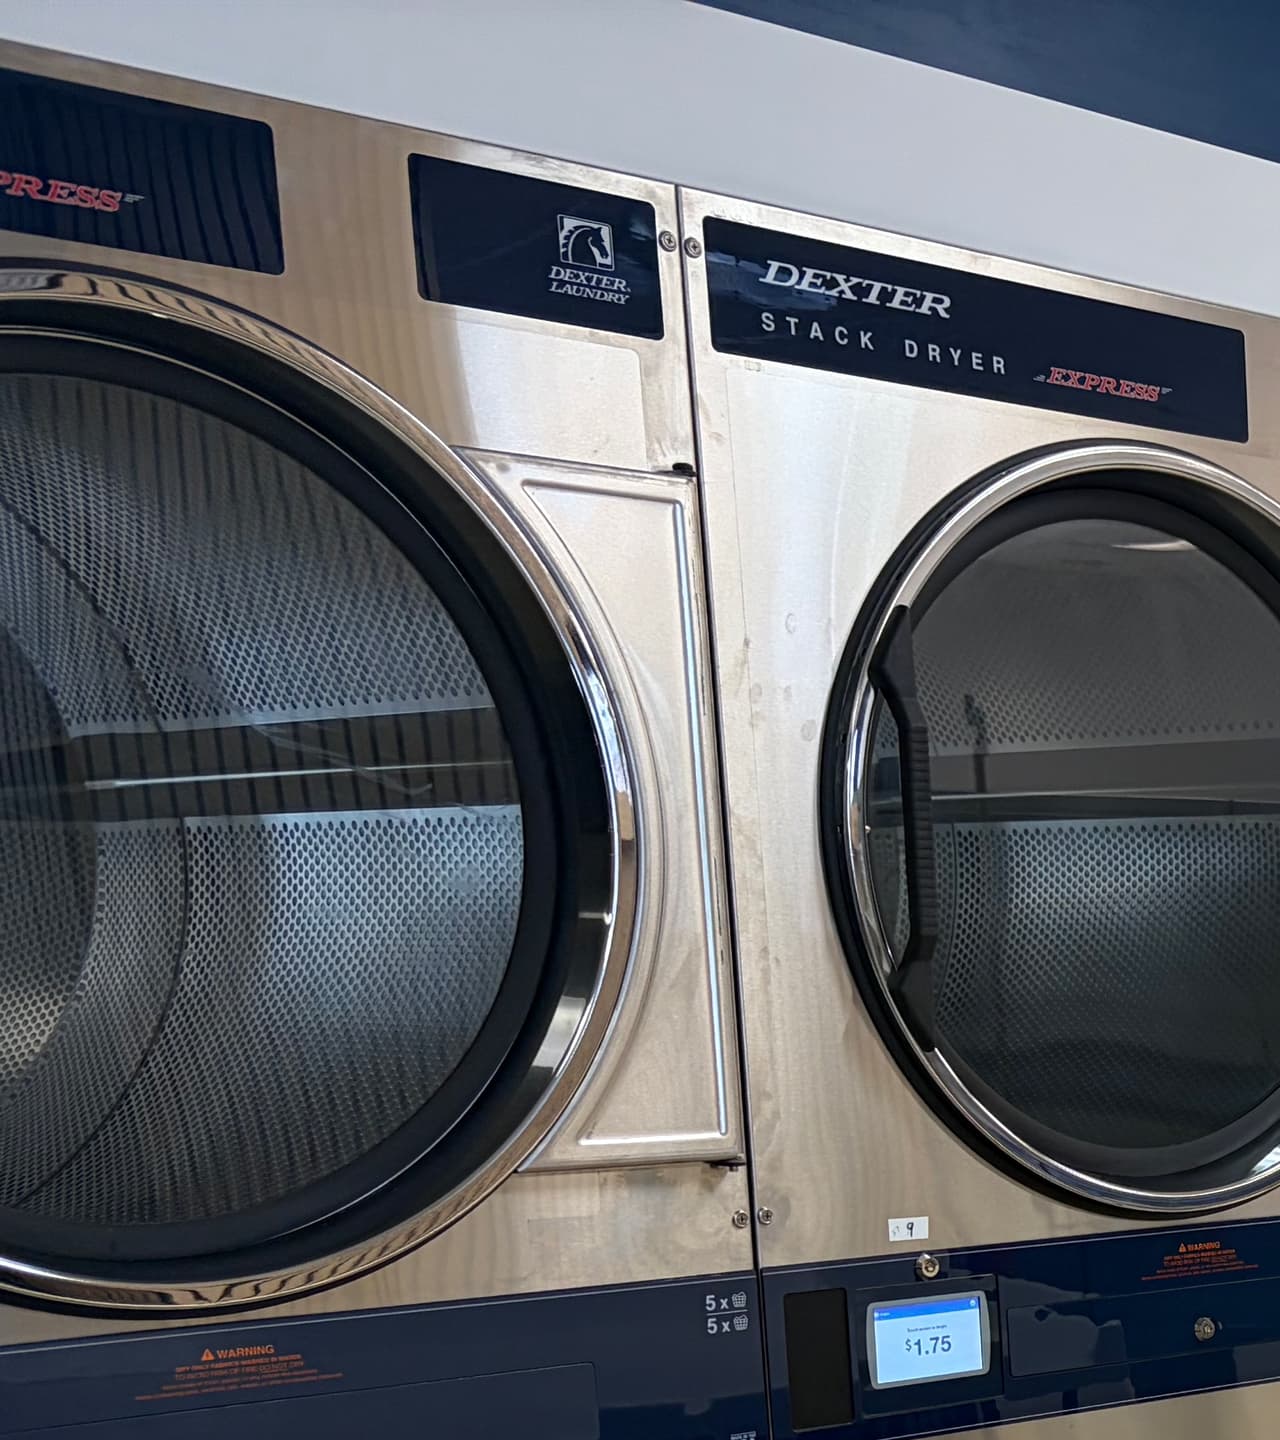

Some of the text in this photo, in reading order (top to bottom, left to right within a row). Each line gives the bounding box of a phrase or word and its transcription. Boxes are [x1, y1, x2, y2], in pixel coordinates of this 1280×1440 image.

[0, 170, 122, 212] RESS
[548, 266, 628, 292] DEXTER
[758, 260, 952, 319] DEXTER
[548, 281, 630, 305] LAUNDRY
[760, 312, 1005, 375] STACK DRYER
[1046, 367, 1161, 402] EXPRESS
[906, 1221, 914, 1238] 9
[705, 1294, 729, 1311] 5 x
[707, 1317, 731, 1335] 5 x
[216, 1344, 275, 1359] WARNING
[905, 1335, 951, 1357] $1.75
